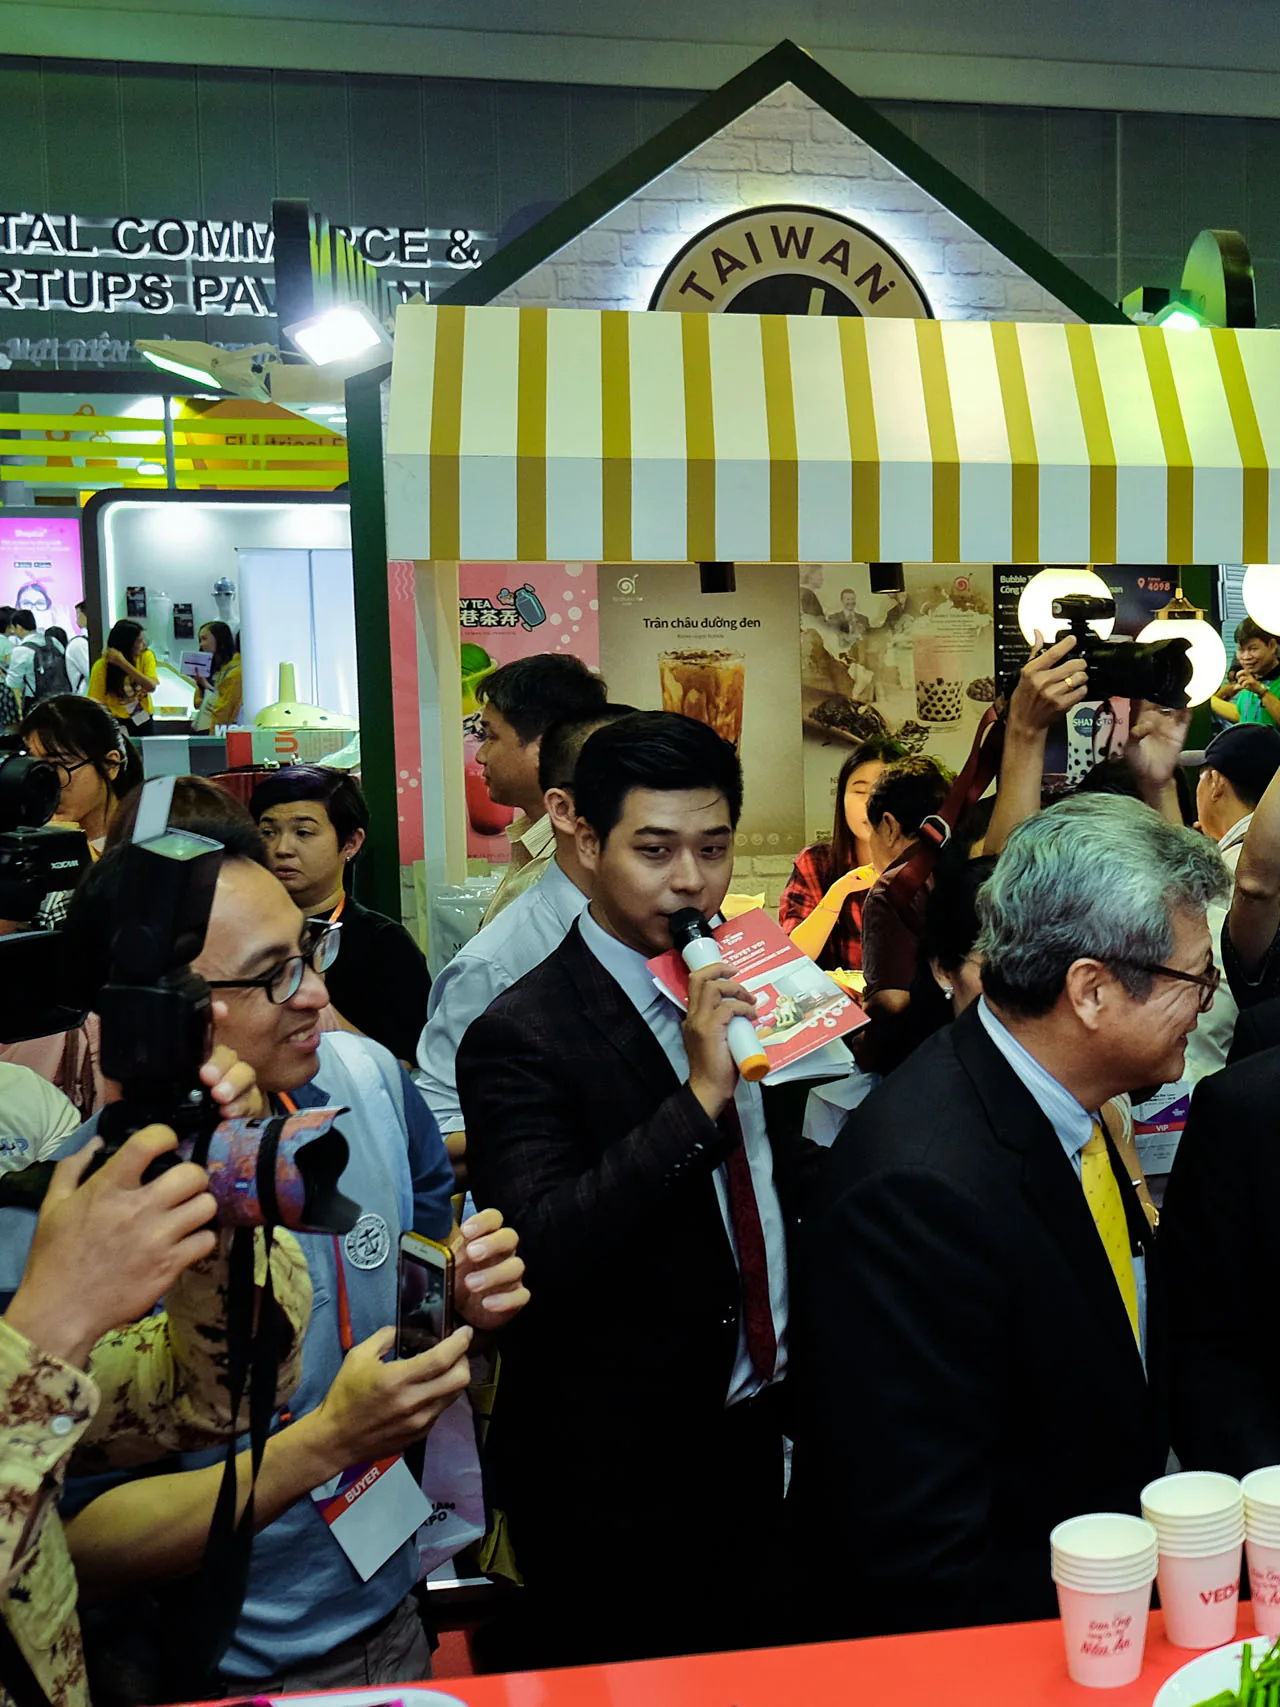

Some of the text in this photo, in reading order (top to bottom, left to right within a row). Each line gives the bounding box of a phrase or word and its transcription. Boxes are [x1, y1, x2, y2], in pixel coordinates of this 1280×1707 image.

[679, 225, 895, 304] TAIWAN
[472, 599, 492, 609] TEA
[643, 615, 761, 631] Trân châu đường đen
[1155, 1124, 1169, 1132] VIP
[345, 1467, 381, 1503] BUYER
